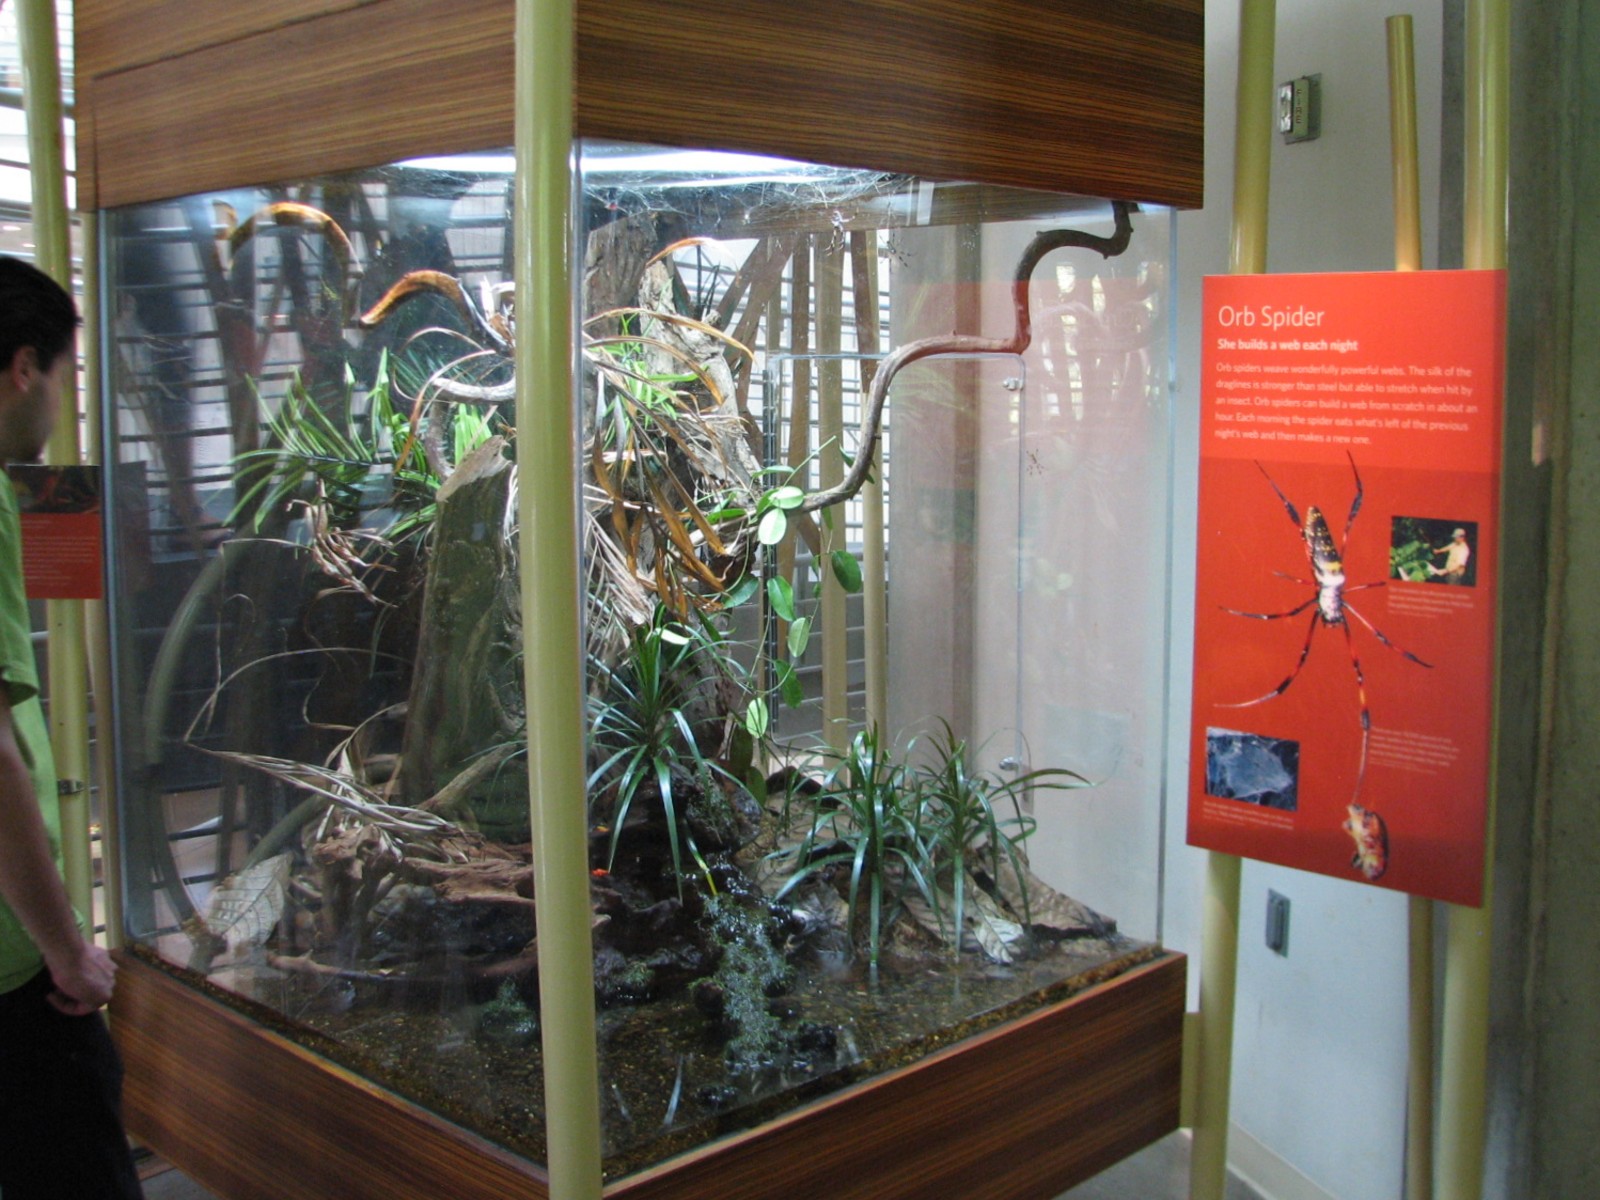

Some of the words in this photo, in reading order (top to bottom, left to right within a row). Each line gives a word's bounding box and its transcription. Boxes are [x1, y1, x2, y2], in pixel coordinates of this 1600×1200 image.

[1218, 305, 1254, 327] Orb
[1261, 306, 1325, 331] Spider
[1217, 339, 1236, 350] She
[1238, 339, 1268, 350] builds
[1270, 342, 1277, 350] a
[1279, 340, 1300, 351] web
[1303, 340, 1328, 352] each
[1330, 340, 1358, 352] night
[1216, 363, 1231, 372] Orb
[1233, 364, 1261, 373] spiders
[1290, 365, 1339, 375] wonderfully
[1341, 365, 1379, 375] powerful
[1381, 366, 1405, 376] webs.
[1408, 366, 1425, 376] The
[1427, 366, 1442, 376] silk
[1444, 367, 1454, 376] of
[1456, 367, 1472, 376] the
[1216, 380, 1251, 390] draglines
[1261, 382, 1295, 391] stronger
[1339, 383, 1354, 392] but
[1355, 384, 1374, 392] able
[1387, 385, 1418, 393] stretch
[1420, 385, 1444, 394] when
[1446, 386, 1459, 394] hit
[1461, 386, 1472, 396] by
[1255, 397, 1270, 406] Orb
[1272, 398, 1301, 408] spiders
[1319, 399, 1340, 408] build
[1349, 401, 1367, 409] web
[1369, 400, 1390, 409] from
[1392, 402, 1425, 411] scratch
[1427, 403, 1435, 411] in
[1437, 404, 1463, 412] about
[1215, 412, 1234, 421] hour.
[1236, 413, 1255, 422] Each
[1257, 414, 1290, 426] morning
[1292, 416, 1306, 424] the
[1308, 417, 1334, 426] spider
[1355, 418, 1383, 427] what's
[1385, 419, 1400, 428] left
[1401, 419, 1411, 428] of
[1412, 420, 1428, 429] the
[1429, 422, 1468, 431] previous
[1214, 429, 1241, 439] night's
[1242, 430, 1259, 438] web
[1260, 431, 1276, 439] and
[1278, 431, 1296, 440] then
[1298, 433, 1324, 442] makes
